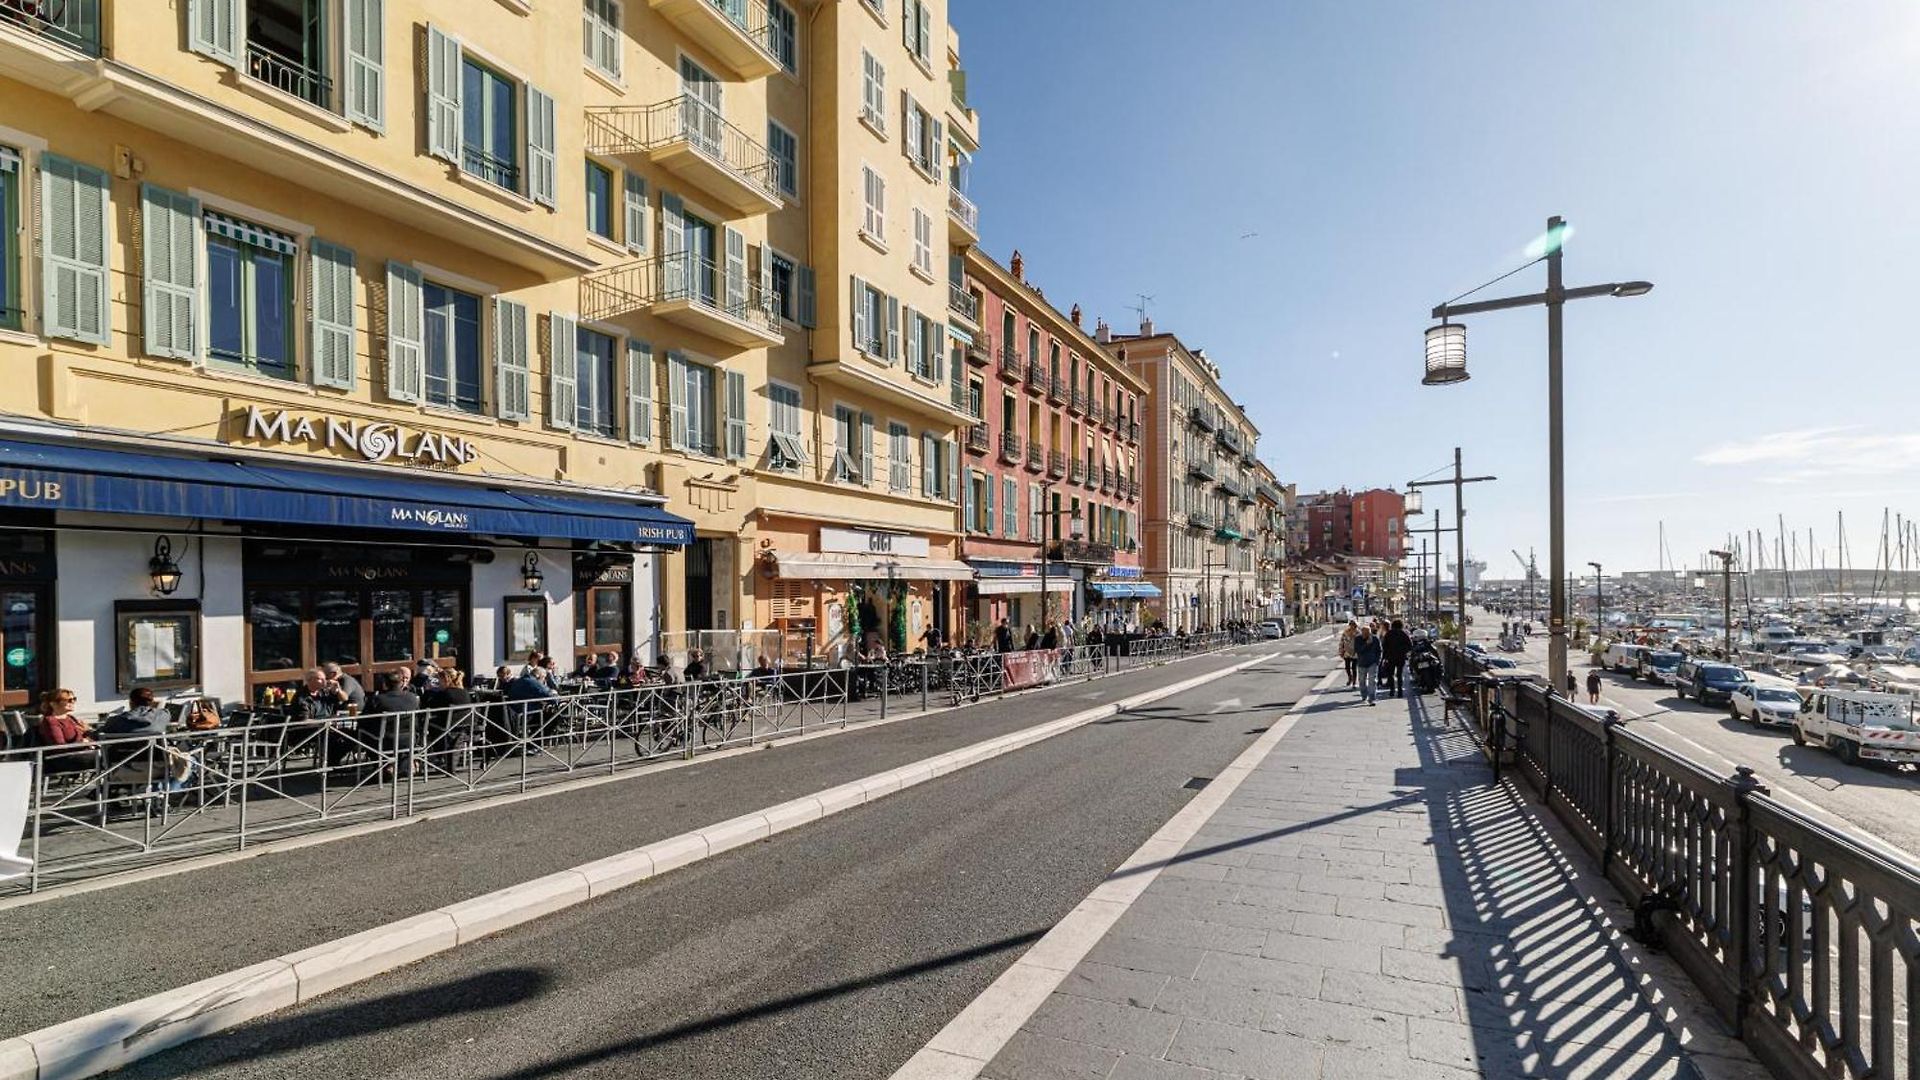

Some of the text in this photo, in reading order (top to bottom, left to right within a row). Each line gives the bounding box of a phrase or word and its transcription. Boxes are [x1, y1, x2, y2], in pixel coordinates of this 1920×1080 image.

[0, 478, 61, 500] PUB
[639, 527, 684, 539] IRISH PUB
[869, 533, 891, 551] GIGI
